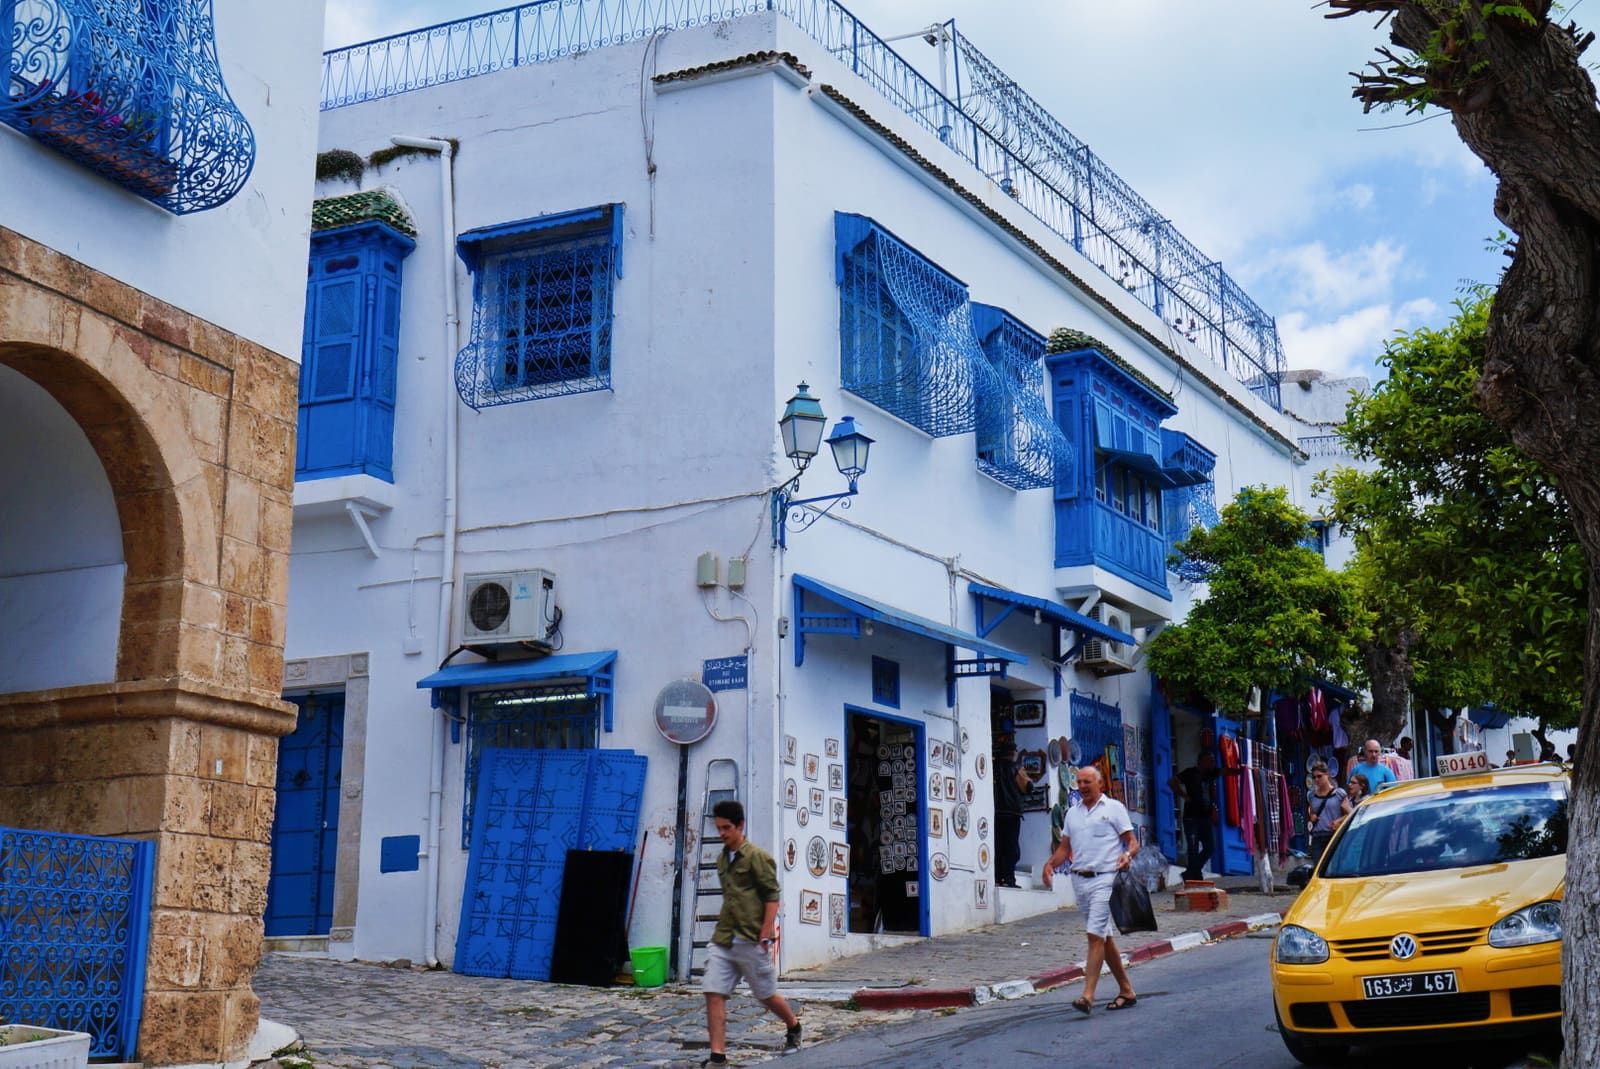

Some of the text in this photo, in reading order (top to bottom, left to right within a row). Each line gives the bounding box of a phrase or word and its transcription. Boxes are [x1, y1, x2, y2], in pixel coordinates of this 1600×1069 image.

[1450, 754, 1486, 772] 0140
[1366, 973, 1454, 997] 163 تونس 467
